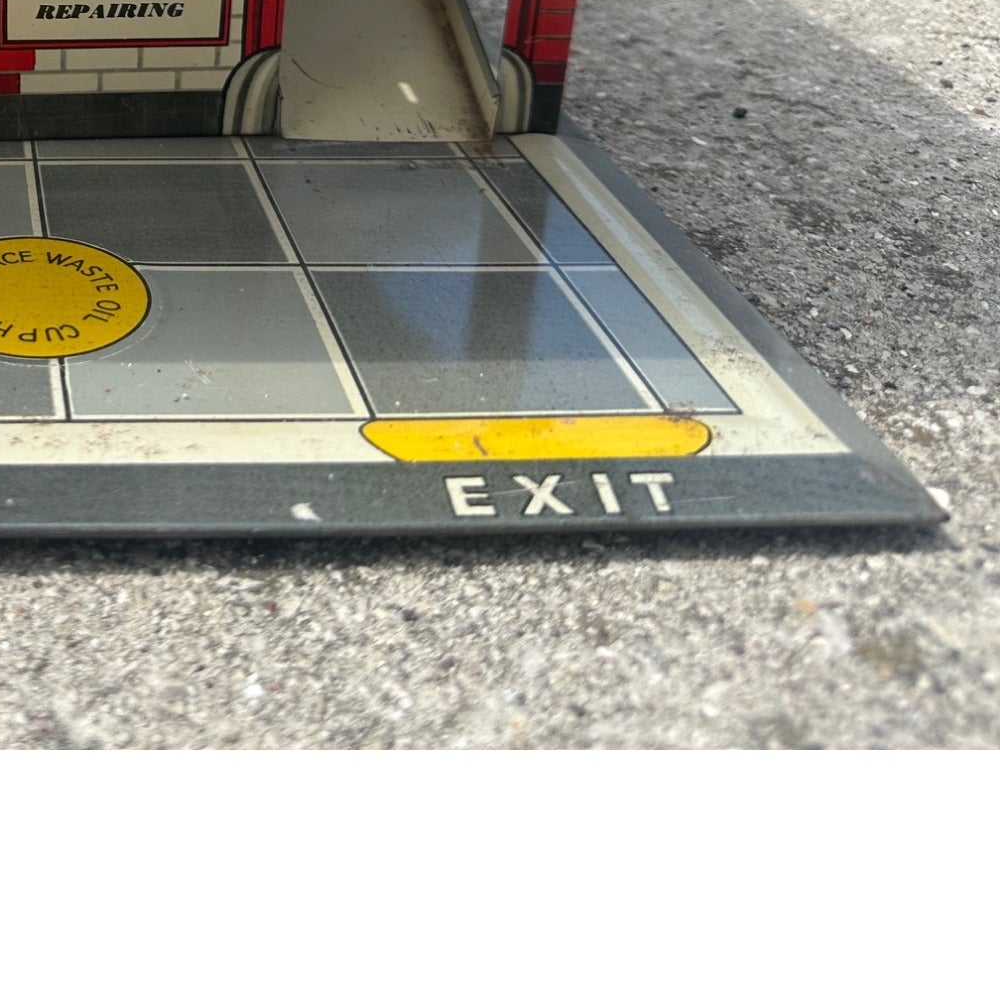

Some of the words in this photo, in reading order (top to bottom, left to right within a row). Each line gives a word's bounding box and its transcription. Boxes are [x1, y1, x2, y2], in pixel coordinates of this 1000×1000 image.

[34, 2, 185, 20] REPAIRING
[46, 251, 119, 293] WASTE
[82, 299, 121, 323] OIL
[18, 324, 80, 343] CUP
[445, 473, 674, 516] EXIT
